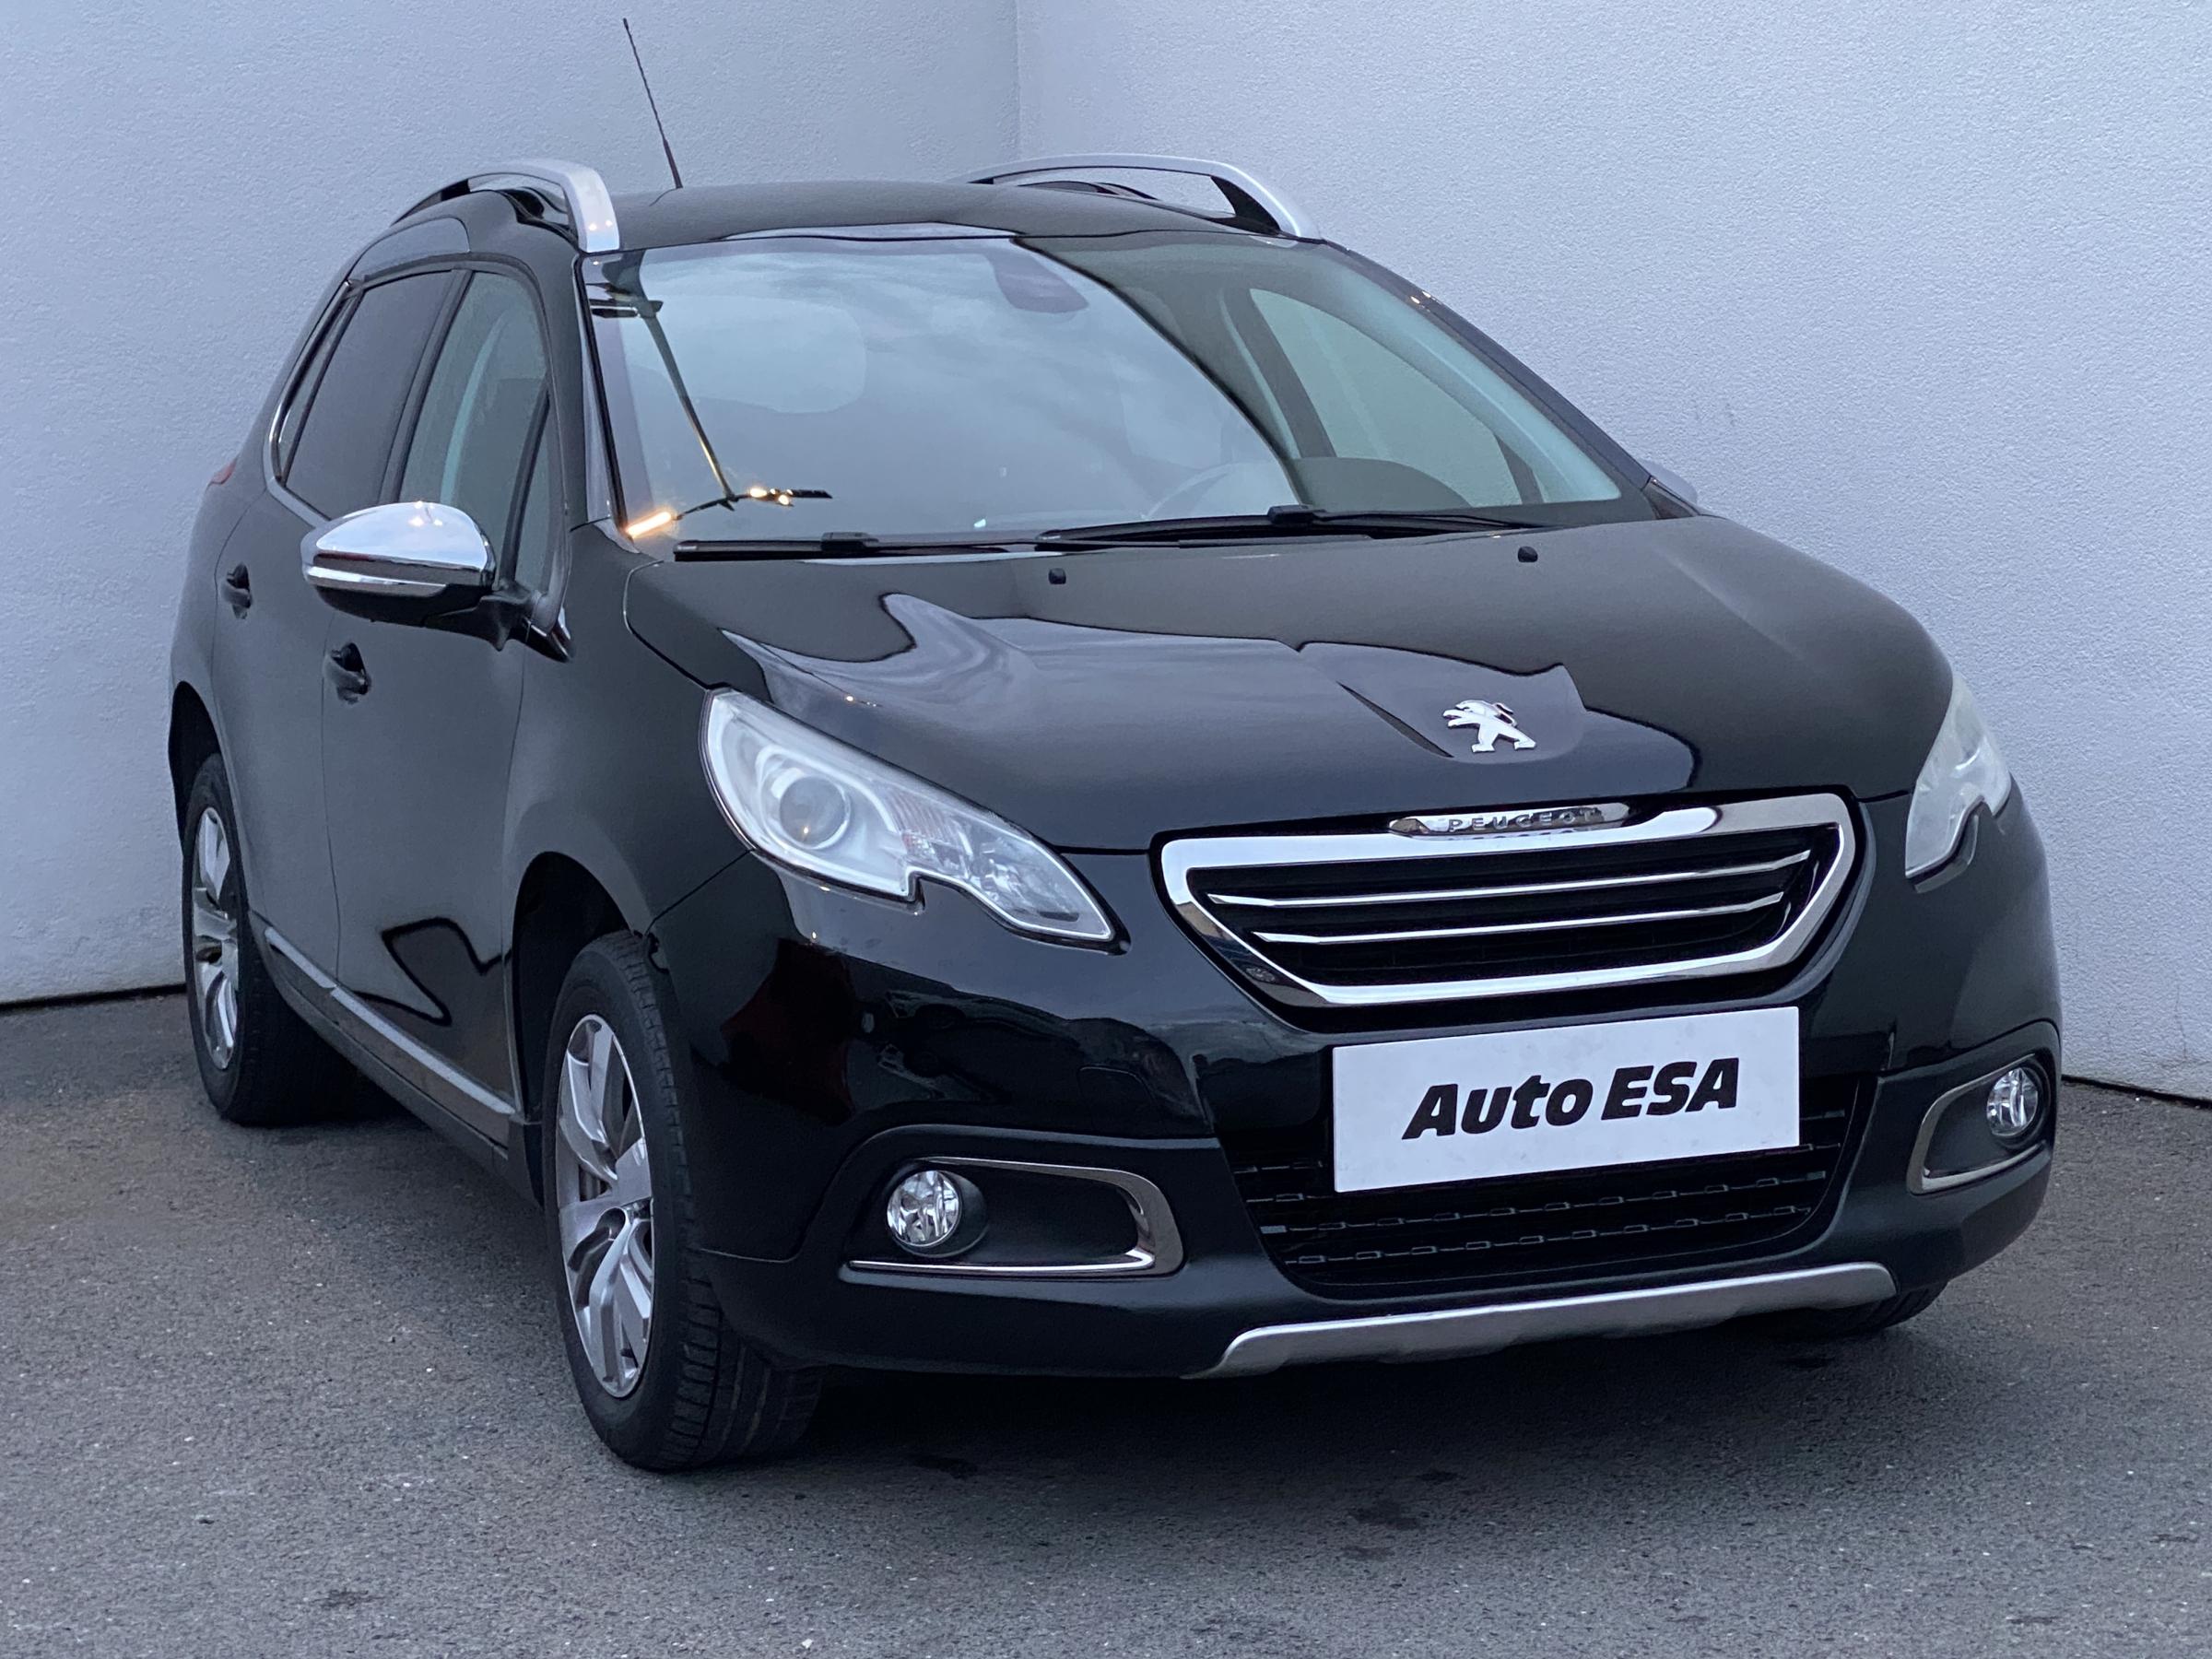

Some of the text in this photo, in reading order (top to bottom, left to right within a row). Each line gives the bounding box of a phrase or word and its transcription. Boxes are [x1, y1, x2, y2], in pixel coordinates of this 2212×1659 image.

[1448, 806, 1602, 832] PEUGEOT
[1402, 1057, 1740, 1140] Auto ESA
